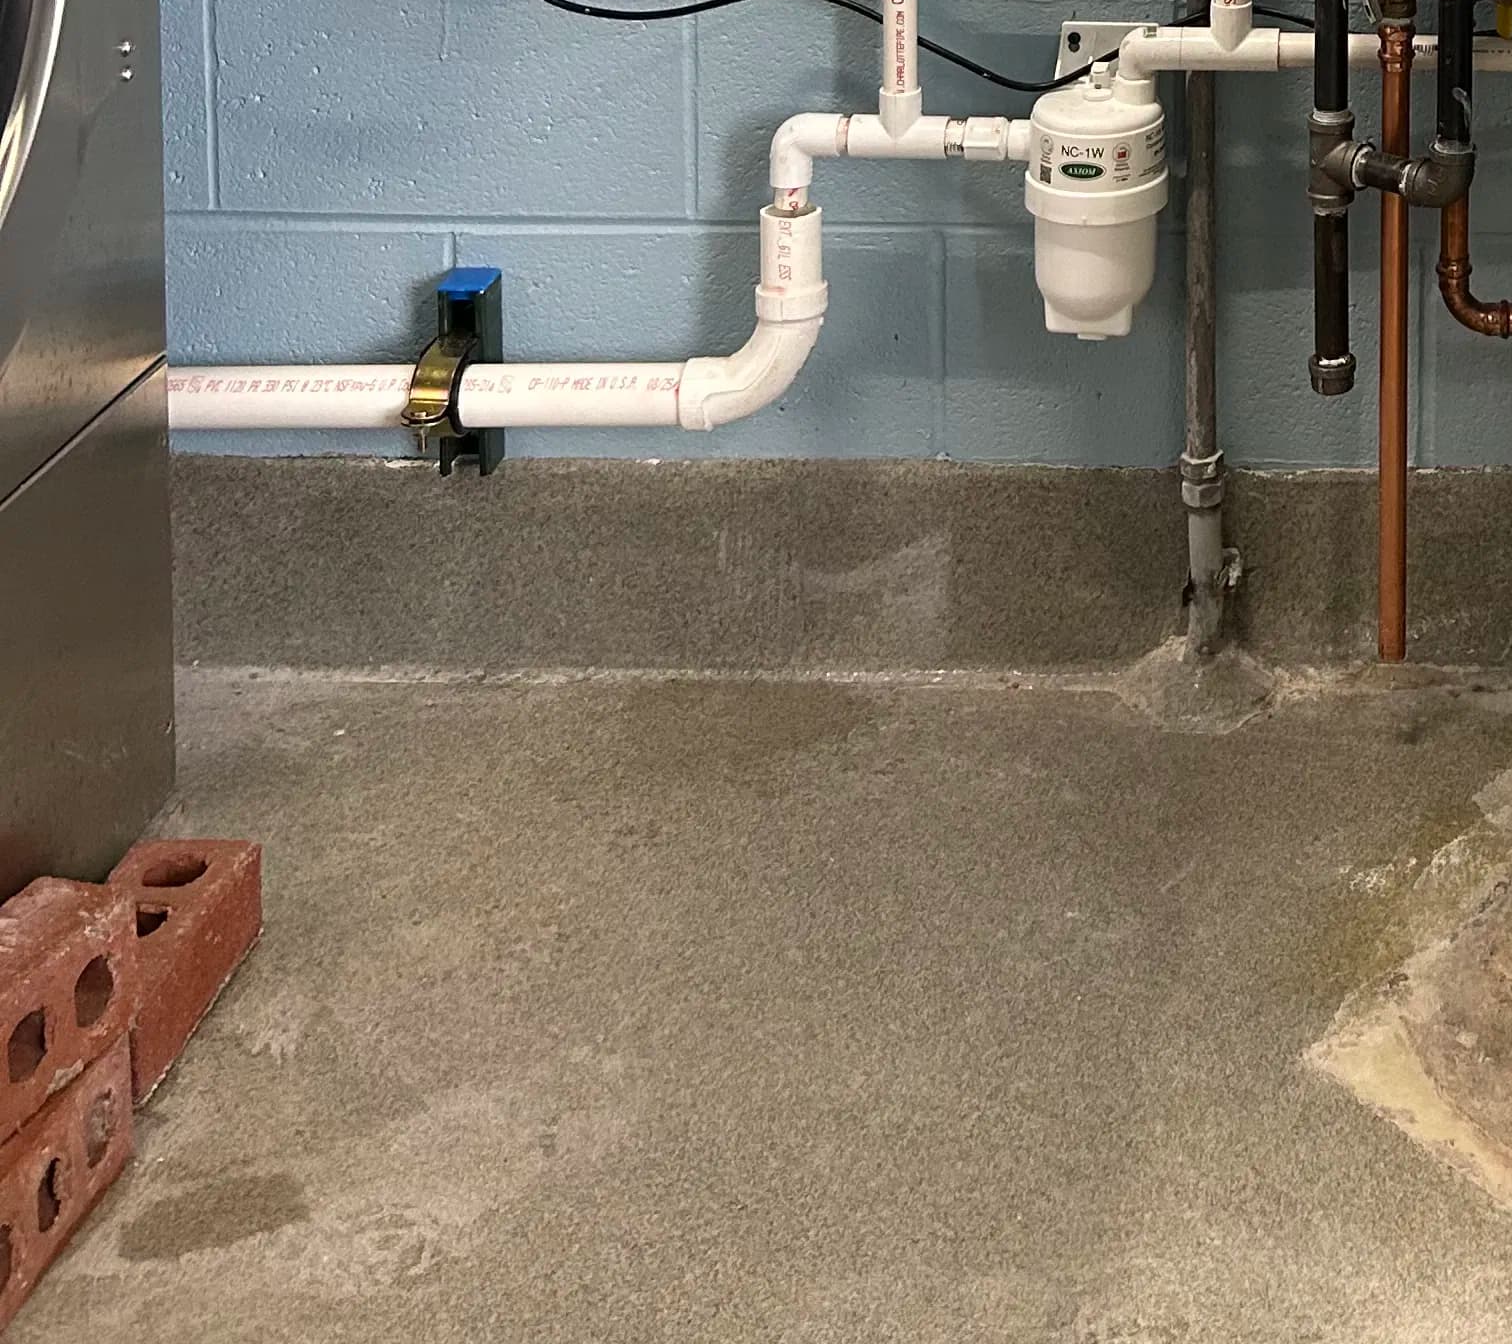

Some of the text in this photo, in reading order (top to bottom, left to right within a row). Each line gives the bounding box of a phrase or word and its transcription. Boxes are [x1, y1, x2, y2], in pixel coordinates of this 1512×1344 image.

[1061, 144, 1105, 160] NC-1W
[1067, 166, 1096, 176] AXIOM
[281, 378, 299, 392] PSI
